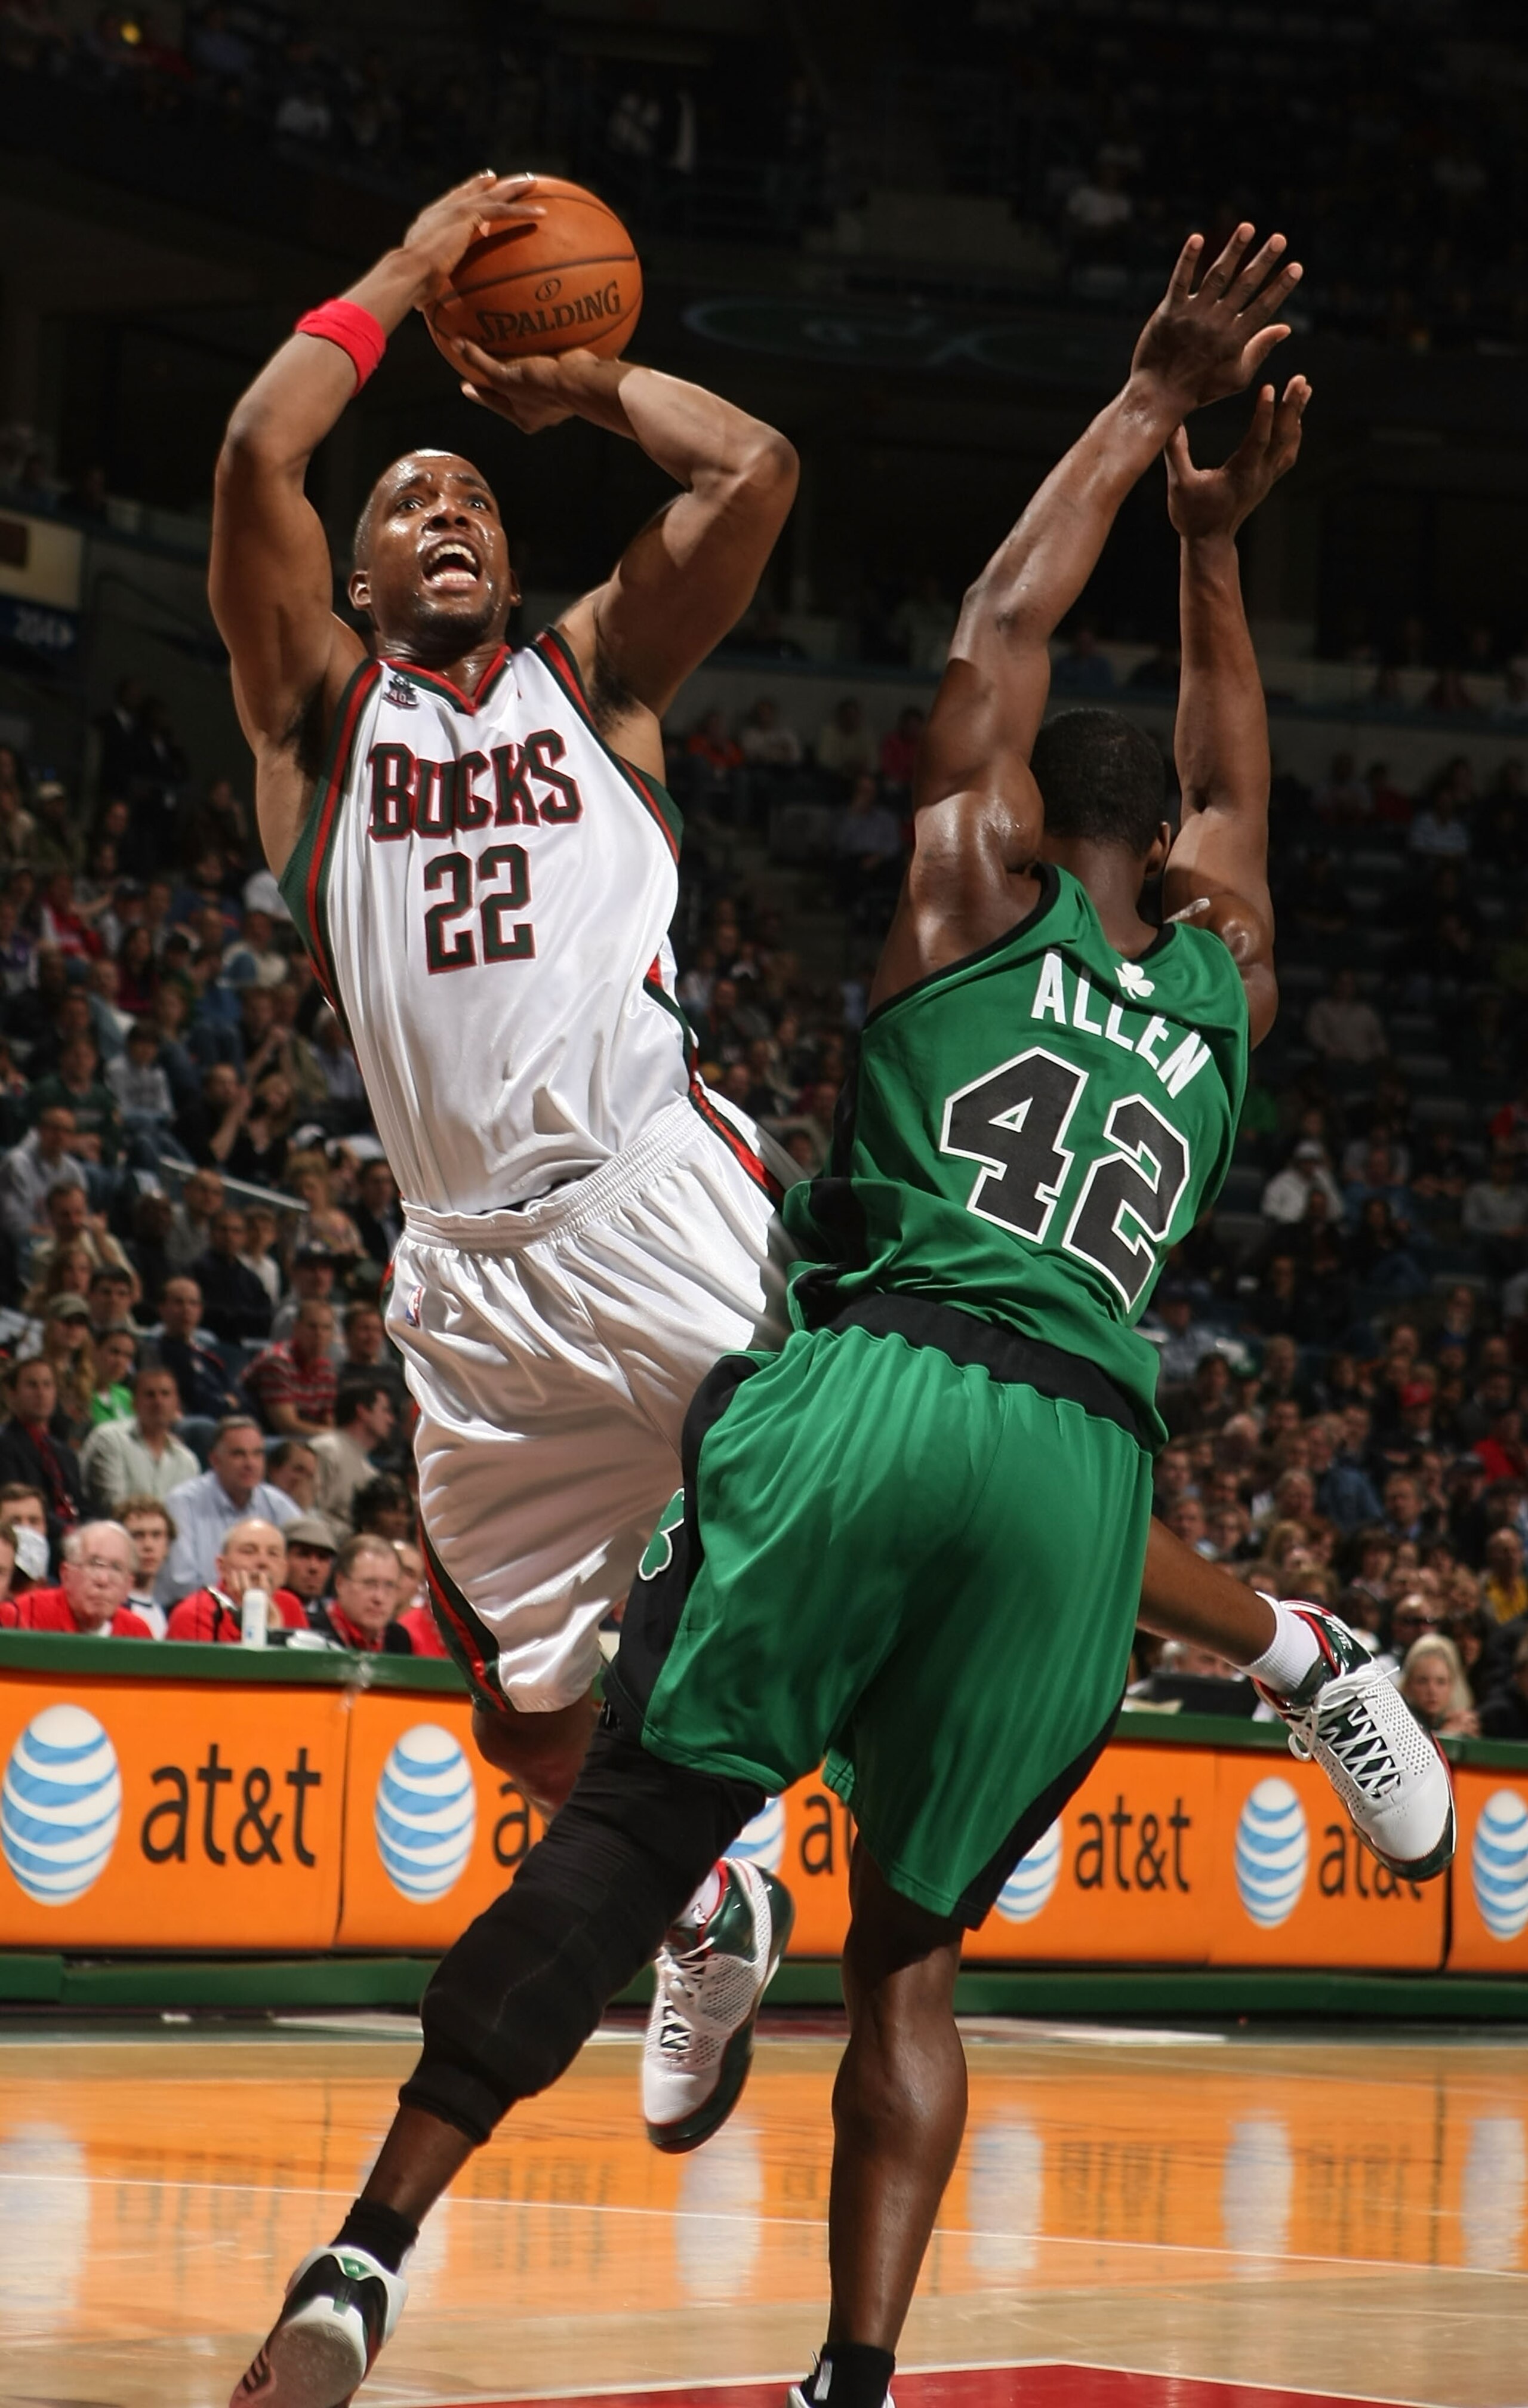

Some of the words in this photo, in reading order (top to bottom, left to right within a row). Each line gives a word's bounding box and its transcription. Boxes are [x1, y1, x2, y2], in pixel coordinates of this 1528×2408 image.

[476, 281, 621, 343] SPALDING
[368, 729, 583, 842] BUCKS
[424, 843, 535, 974] 22
[1031, 949, 1212, 1099] ALLEN
[939, 1046, 1191, 1313] 42
[140, 1743, 321, 1867] at&t
[1074, 1794, 1191, 1893] at&t
